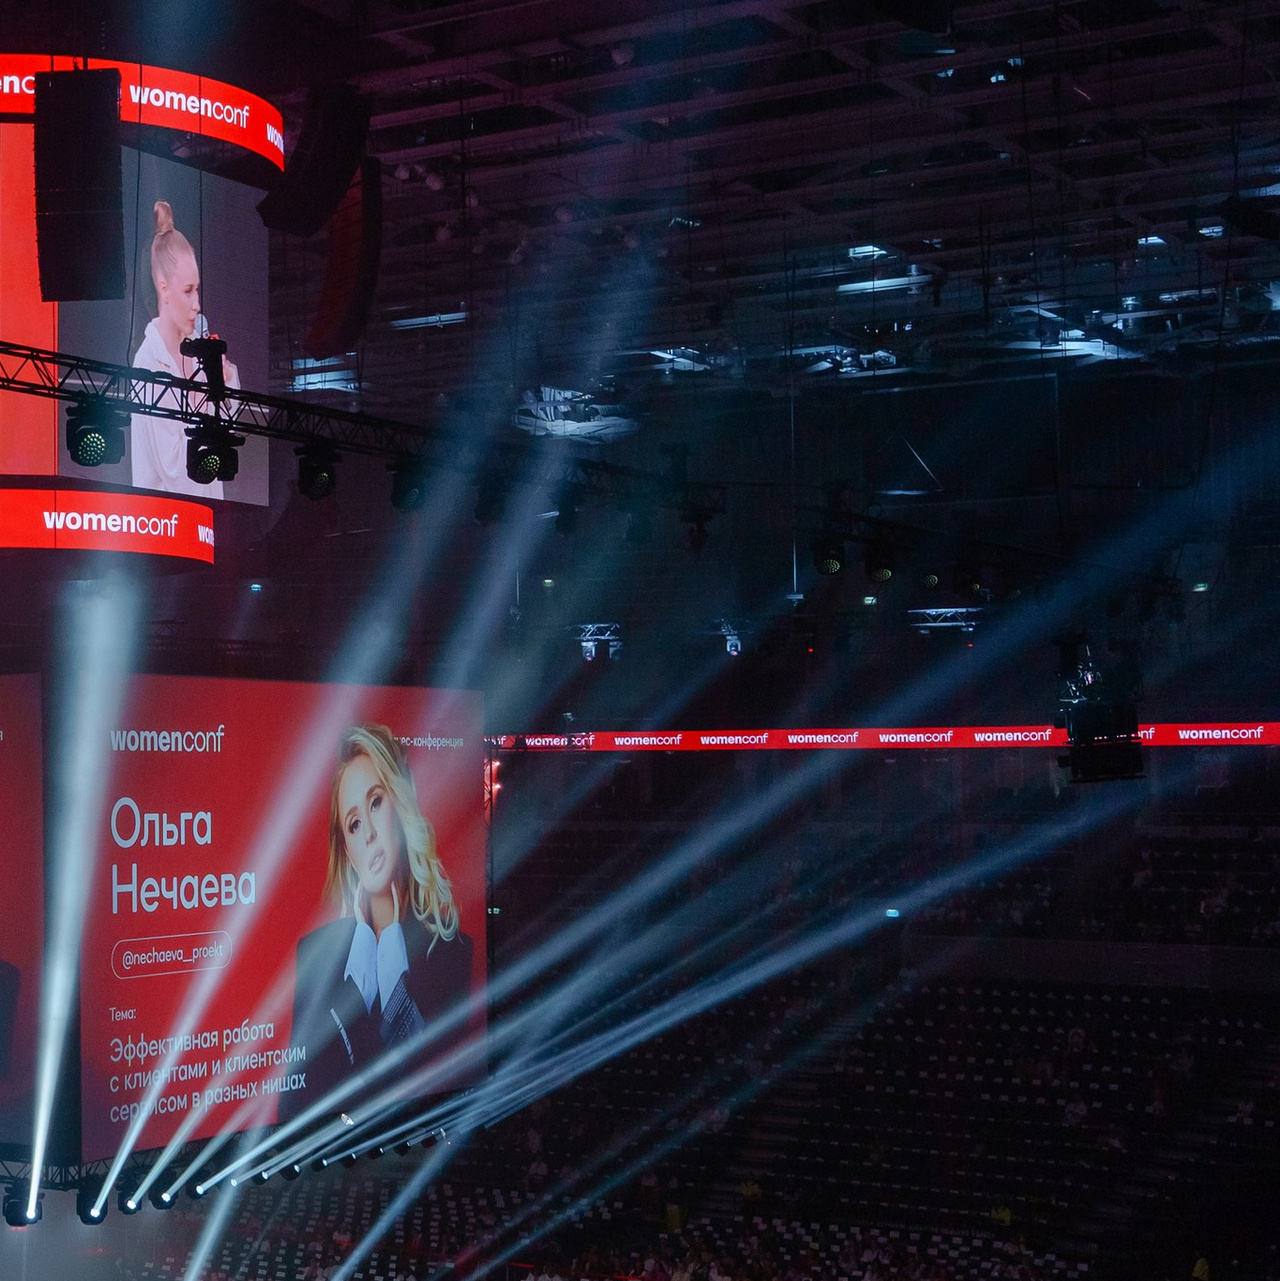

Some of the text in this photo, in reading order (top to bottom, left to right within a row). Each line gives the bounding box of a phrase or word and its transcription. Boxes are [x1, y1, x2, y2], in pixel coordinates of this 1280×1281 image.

[129, 84, 250, 129] womenconf
[43, 510, 179, 538] womenconf
[110, 724, 225, 753] womenconf
[614, 733, 682, 746] womenconf
[700, 732, 769, 745] womenconf
[787, 731, 859, 744] womenconf
[878, 730, 953, 743] womenconf
[974, 729, 1052, 742] womenconf
[1178, 726, 1264, 740] womenconf
[110, 796, 212, 849] Ольга
[112, 862, 256, 915] Нечаева
[109, 1006, 137, 1023] Тема:
[109, 1018, 274, 1067] Эффективная работа
[109, 1045, 307, 1093] с клиентами и клиентским
[109, 1072, 307, 1126] серисом в разных нишах
